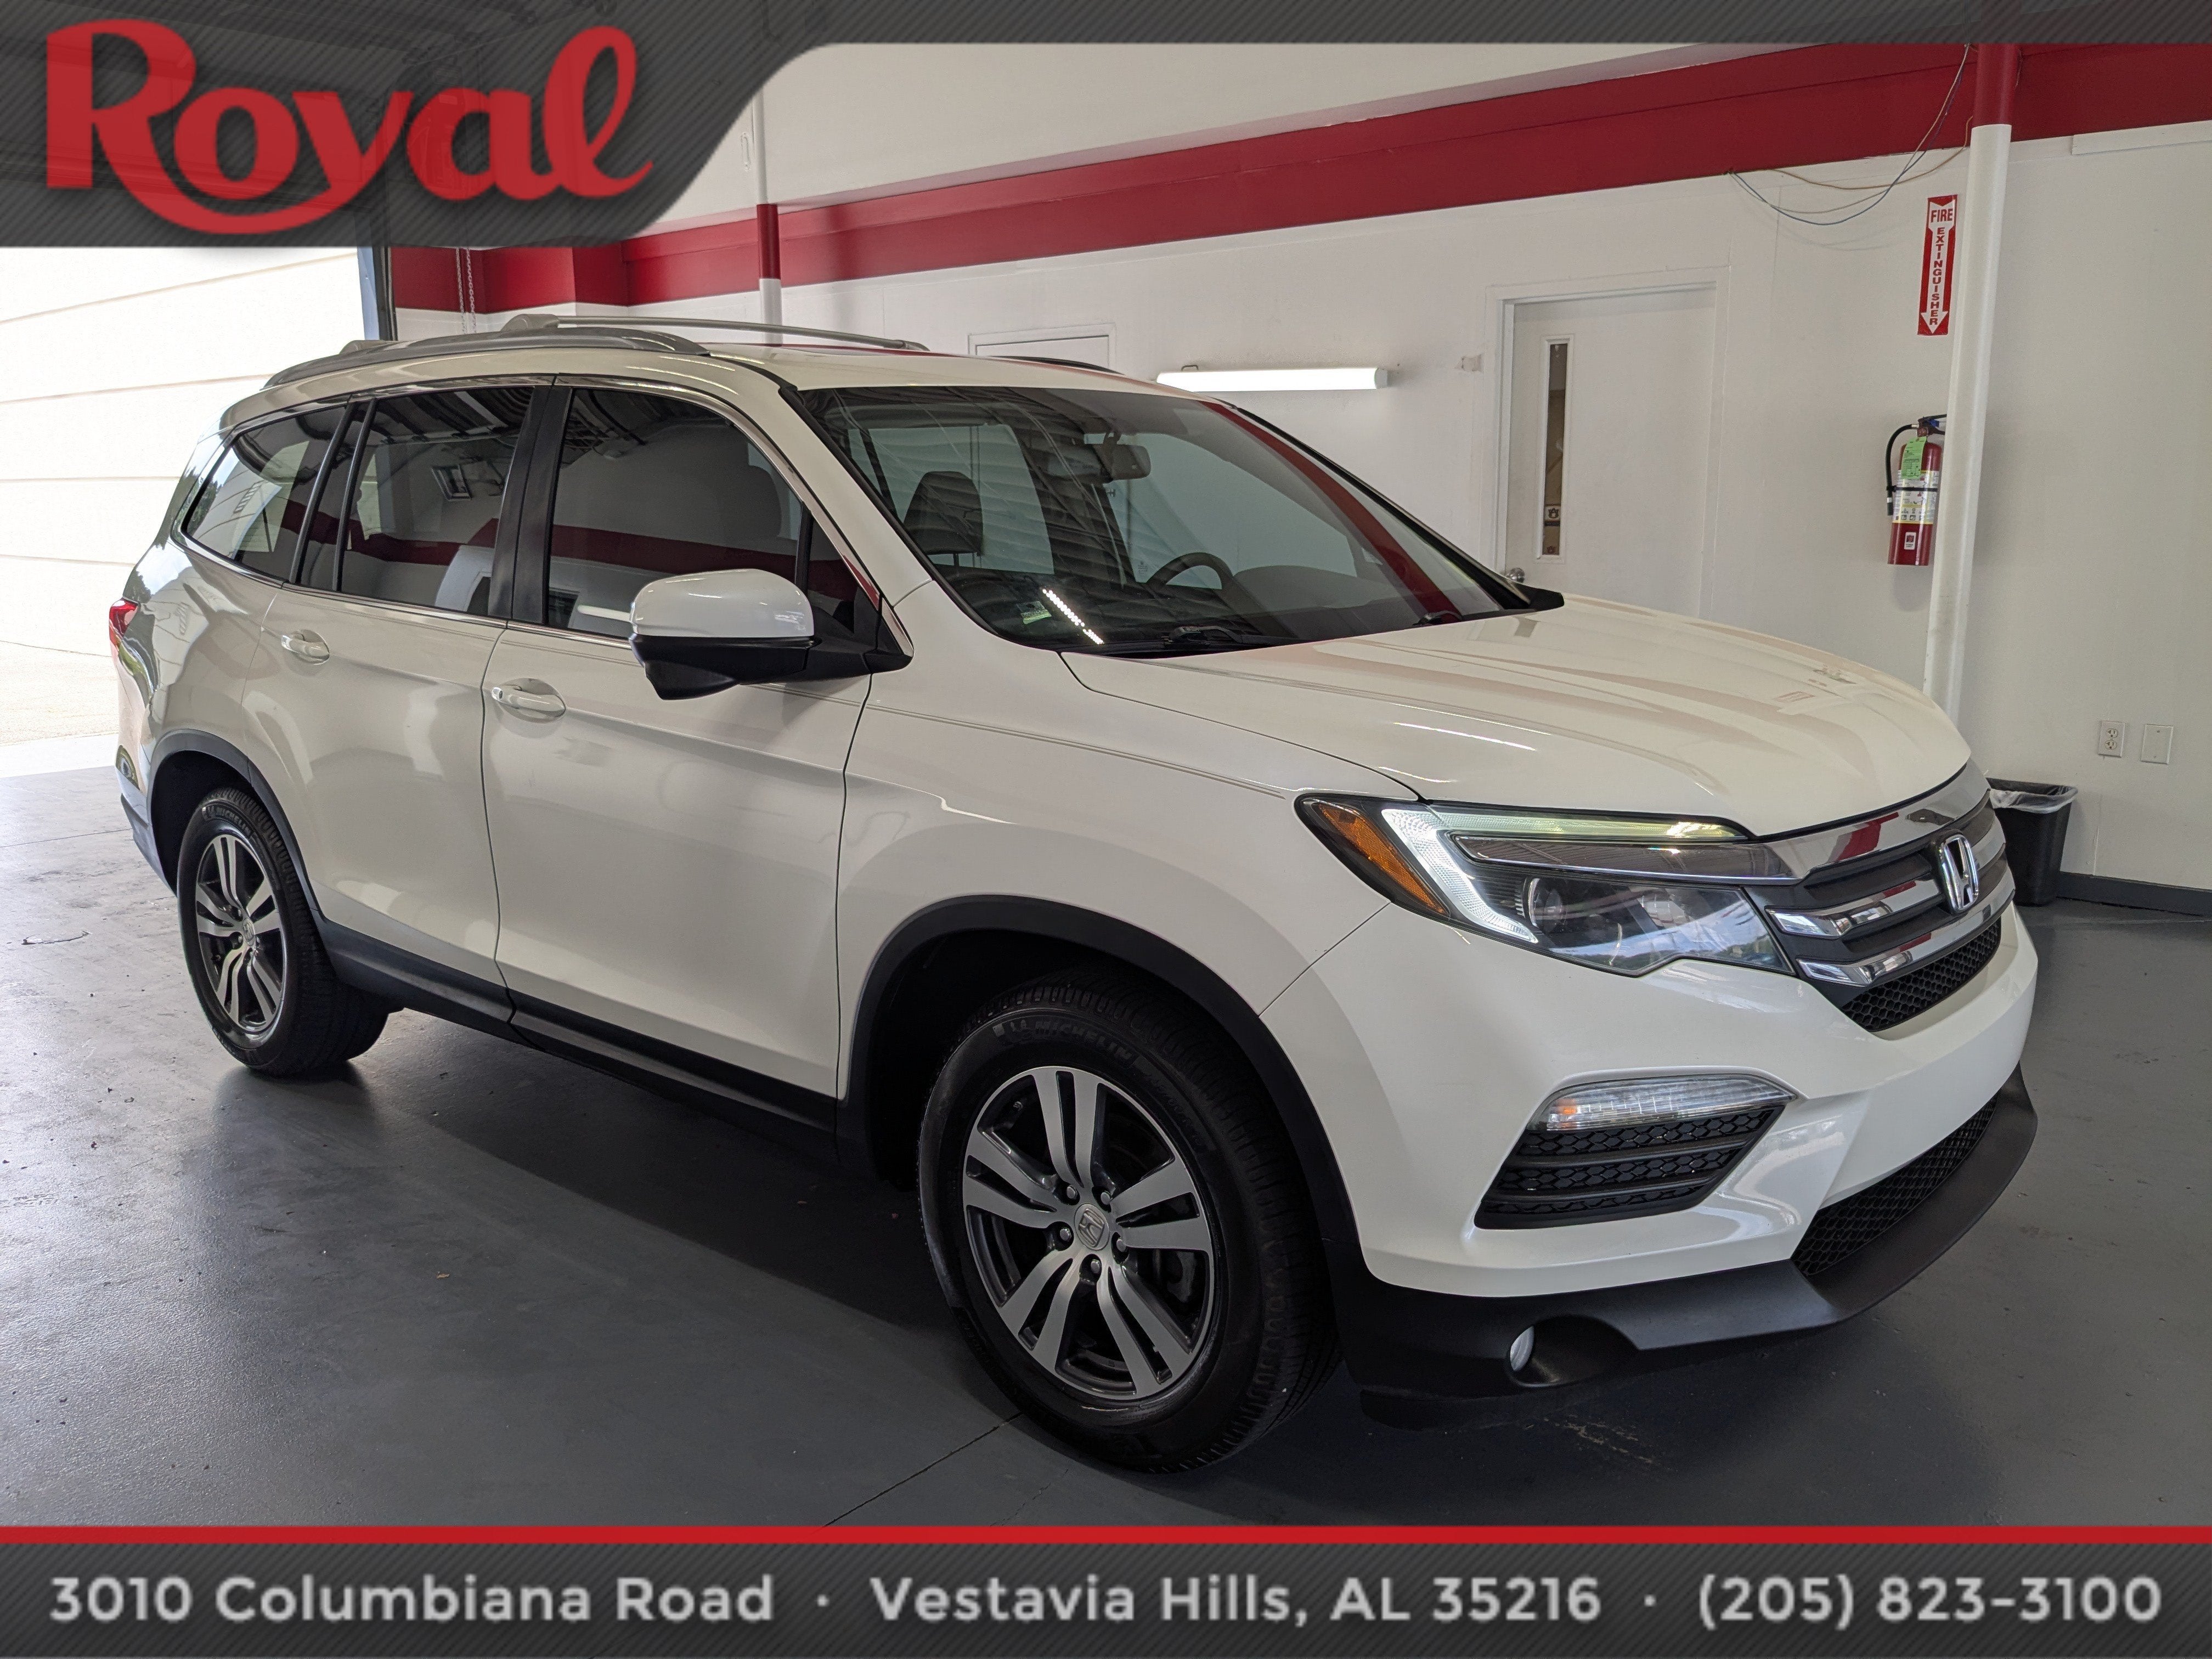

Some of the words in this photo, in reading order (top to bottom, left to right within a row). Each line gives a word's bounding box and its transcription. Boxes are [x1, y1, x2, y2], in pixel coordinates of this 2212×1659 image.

[1931, 208, 1953, 223] FIRE
[1929, 227, 1945, 325] EXTINGUISHER
[215, 806, 252, 837] MICHELIN
[1034, 1020, 1136, 1065] MICHELIN
